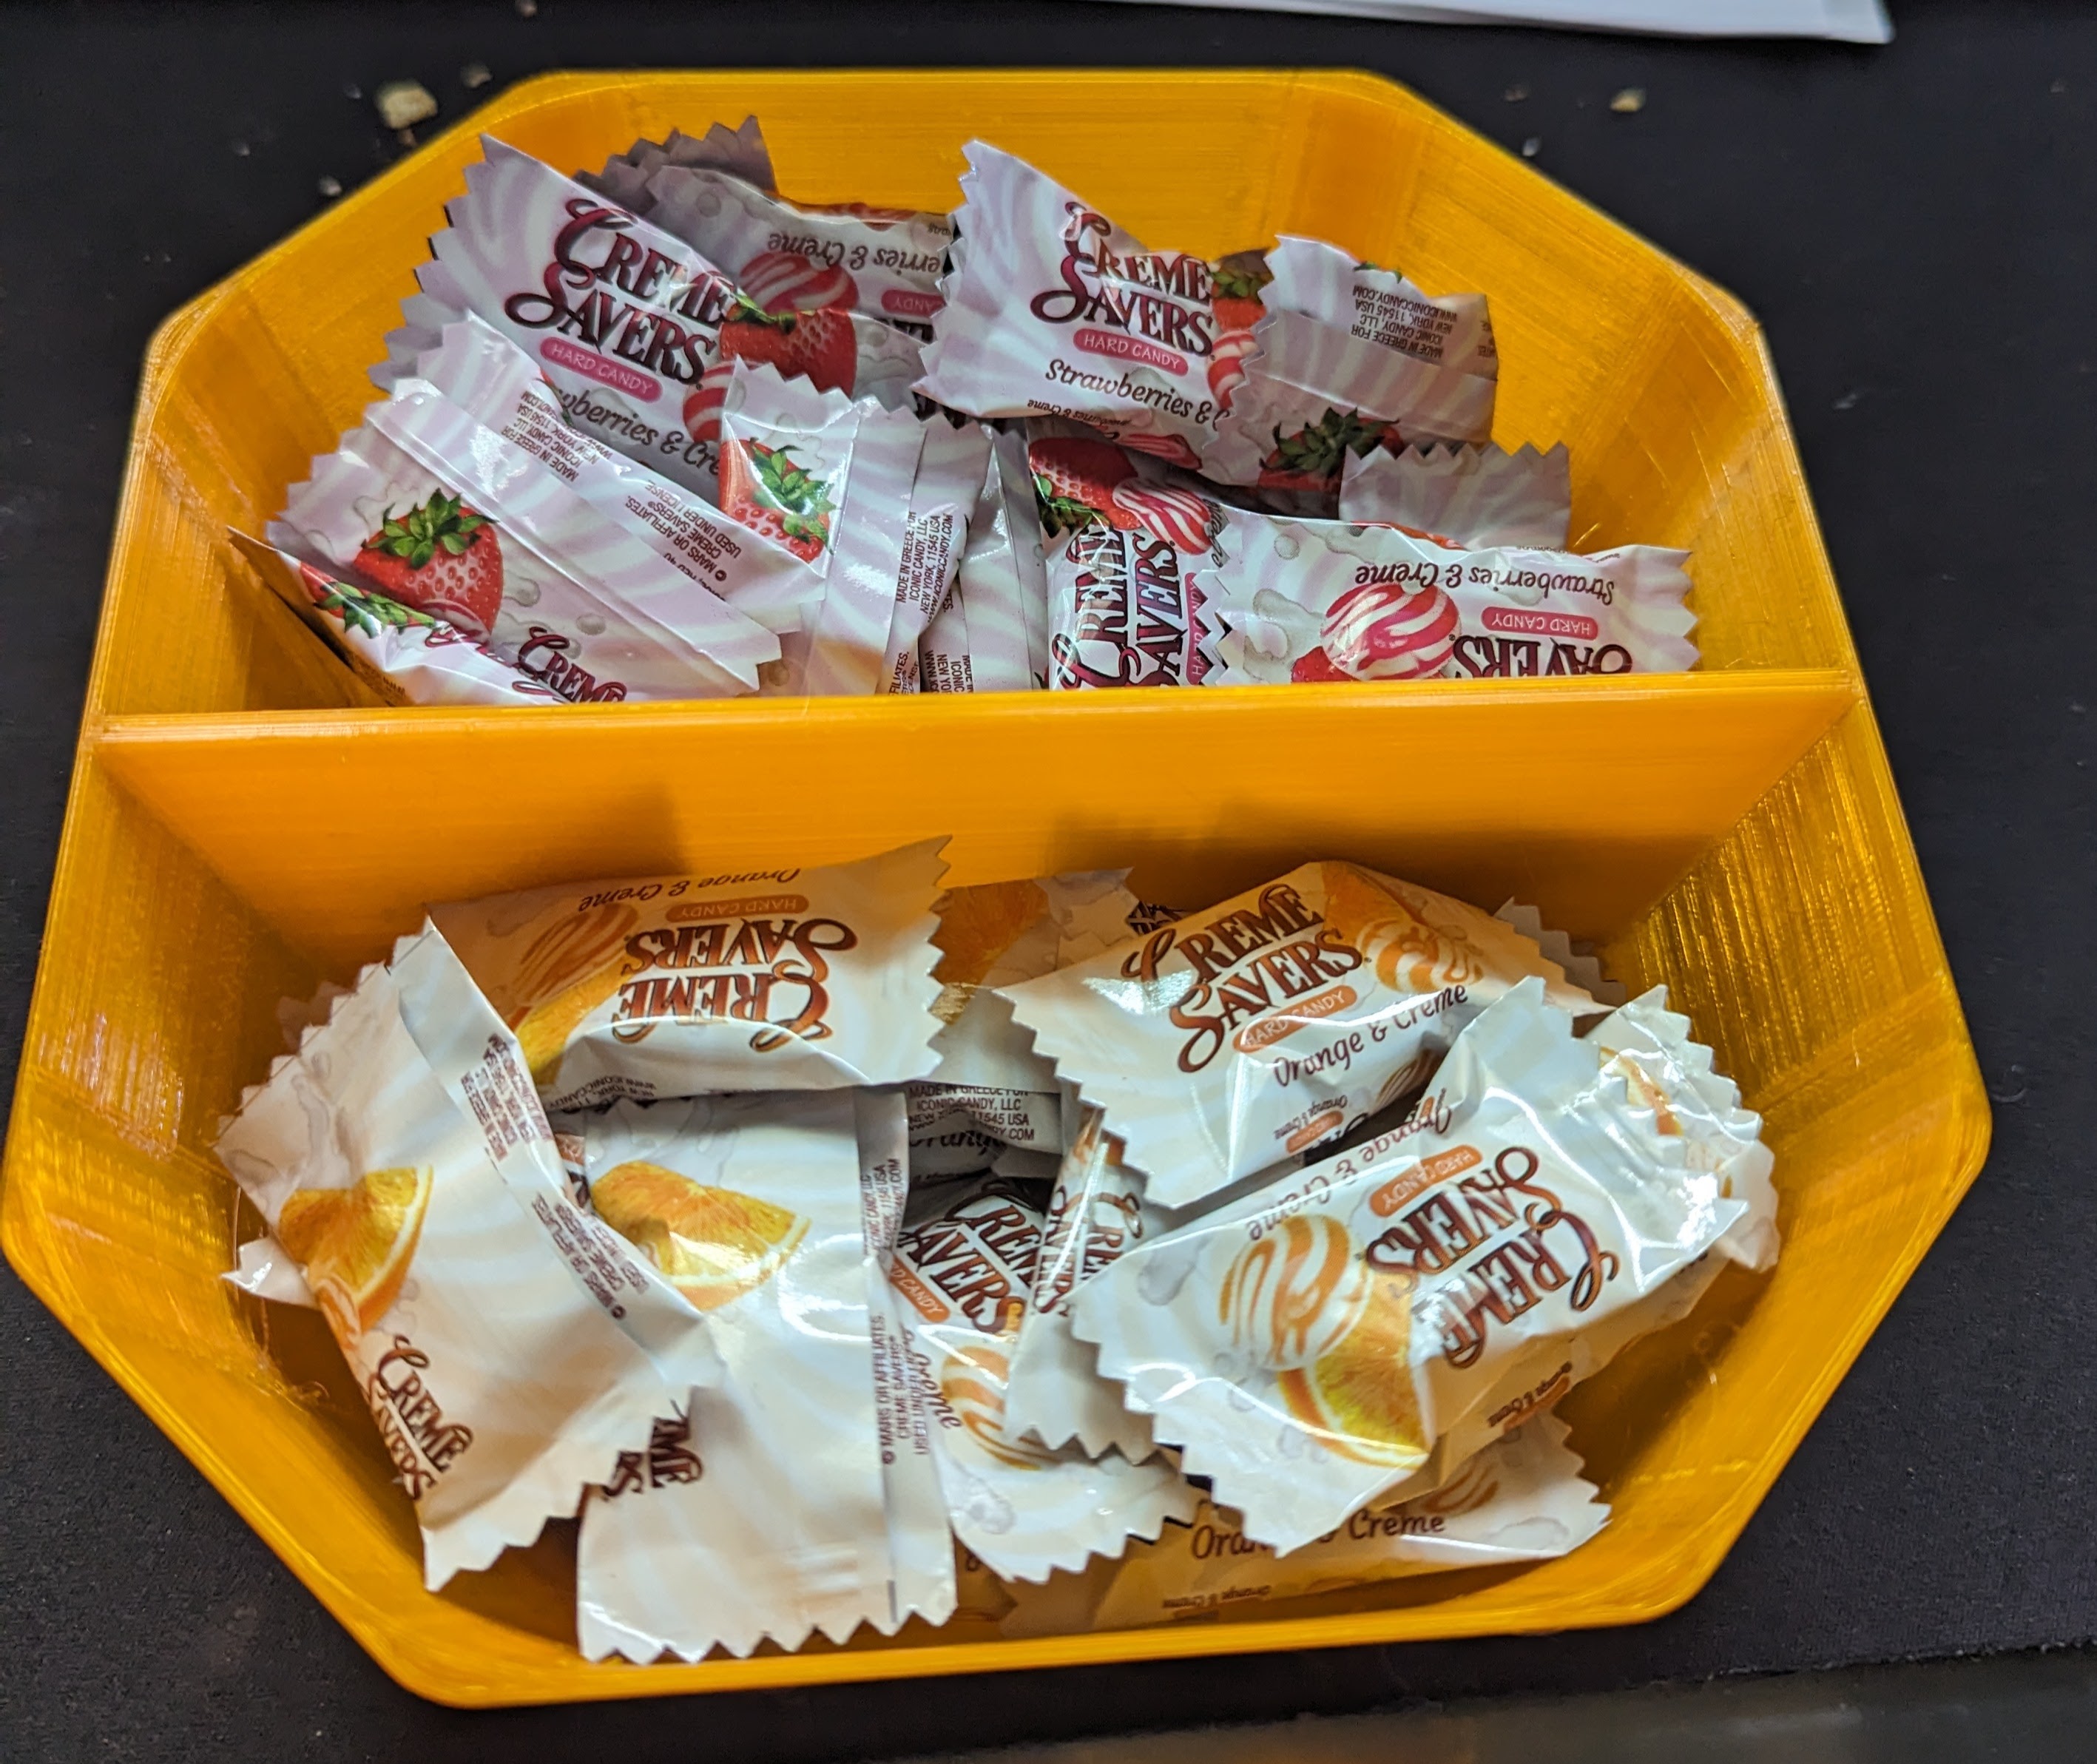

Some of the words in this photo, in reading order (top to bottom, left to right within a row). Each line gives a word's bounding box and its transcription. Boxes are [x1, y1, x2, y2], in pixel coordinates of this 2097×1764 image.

[554, 198, 737, 331] CREME
[768, 232, 846, 268] Creme
[849, 245, 869, 271] &
[873, 248, 942, 277] erries
[1060, 201, 1213, 306] CREME
[894, 296, 937, 312] ANDY
[1030, 255, 1214, 357] SAVERS
[1354, 299, 1375, 314] USA
[504, 261, 717, 385] SAVERS
[1351, 324, 1373, 339] FOR
[1359, 314, 1379, 329] LLC
[1084, 334, 1129, 353] HARD
[1132, 345, 1181, 368] CANDY
[552, 344, 596, 371] HARD
[596, 364, 654, 395] CANDY
[1045, 359, 1194, 419] Strawberries
[1195, 400, 1213, 425] &
[558, 389, 659, 445] wberries
[660, 430, 684, 455] &
[683, 441, 719, 476] Cre
[549, 457, 580, 482] MADE
[550, 442, 584, 468] ICONIC
[683, 510, 717, 537] UNDER
[929, 515, 941, 533] USA
[672, 535, 691, 552] OR
[687, 528, 723, 560] CREME
[715, 533, 742, 559] USED
[925, 533, 940, 562] 11545
[687, 545, 717, 574] MARS
[908, 570, 922, 602] ICONIC
[916, 518, 928, 536] LLC
[1354, 561, 1439, 587] Creme
[896, 575, 910, 604] MADE
[1445, 564, 1463, 589] &
[1468, 566, 1615, 606] Strawberries
[919, 590, 931, 615] NEW
[1490, 612, 1547, 630] CANDY
[1550, 619, 1590, 635] HARD
[937, 654, 950, 676] NEW
[950, 660, 965, 693] ICONIC
[577, 882, 663, 912] Creme
[680, 903, 741, 919] CANDY
[744, 899, 798, 912] HARD
[621, 918, 859, 984] SAVERS
[1121, 884, 1325, 995] CREME
[612, 962, 834, 1052] CREME
[1169, 927, 1364, 1073] SAVERS
[1291, 990, 1346, 1019] CANDY
[1273, 1032, 1365, 1087] Orange
[1393, 984, 1468, 1030] Creme
[1000, 1099, 1022, 1110] LLC
[1007, 1113, 1030, 1126] USA
[1365, 1146, 1563, 1278] SAVERS
[945, 1183, 1043, 1291] CREM
[900, 1277, 945, 1315] CANDY
[376, 1334, 474, 1473] CREME
[1348, 1507, 1448, 1540] Creme
